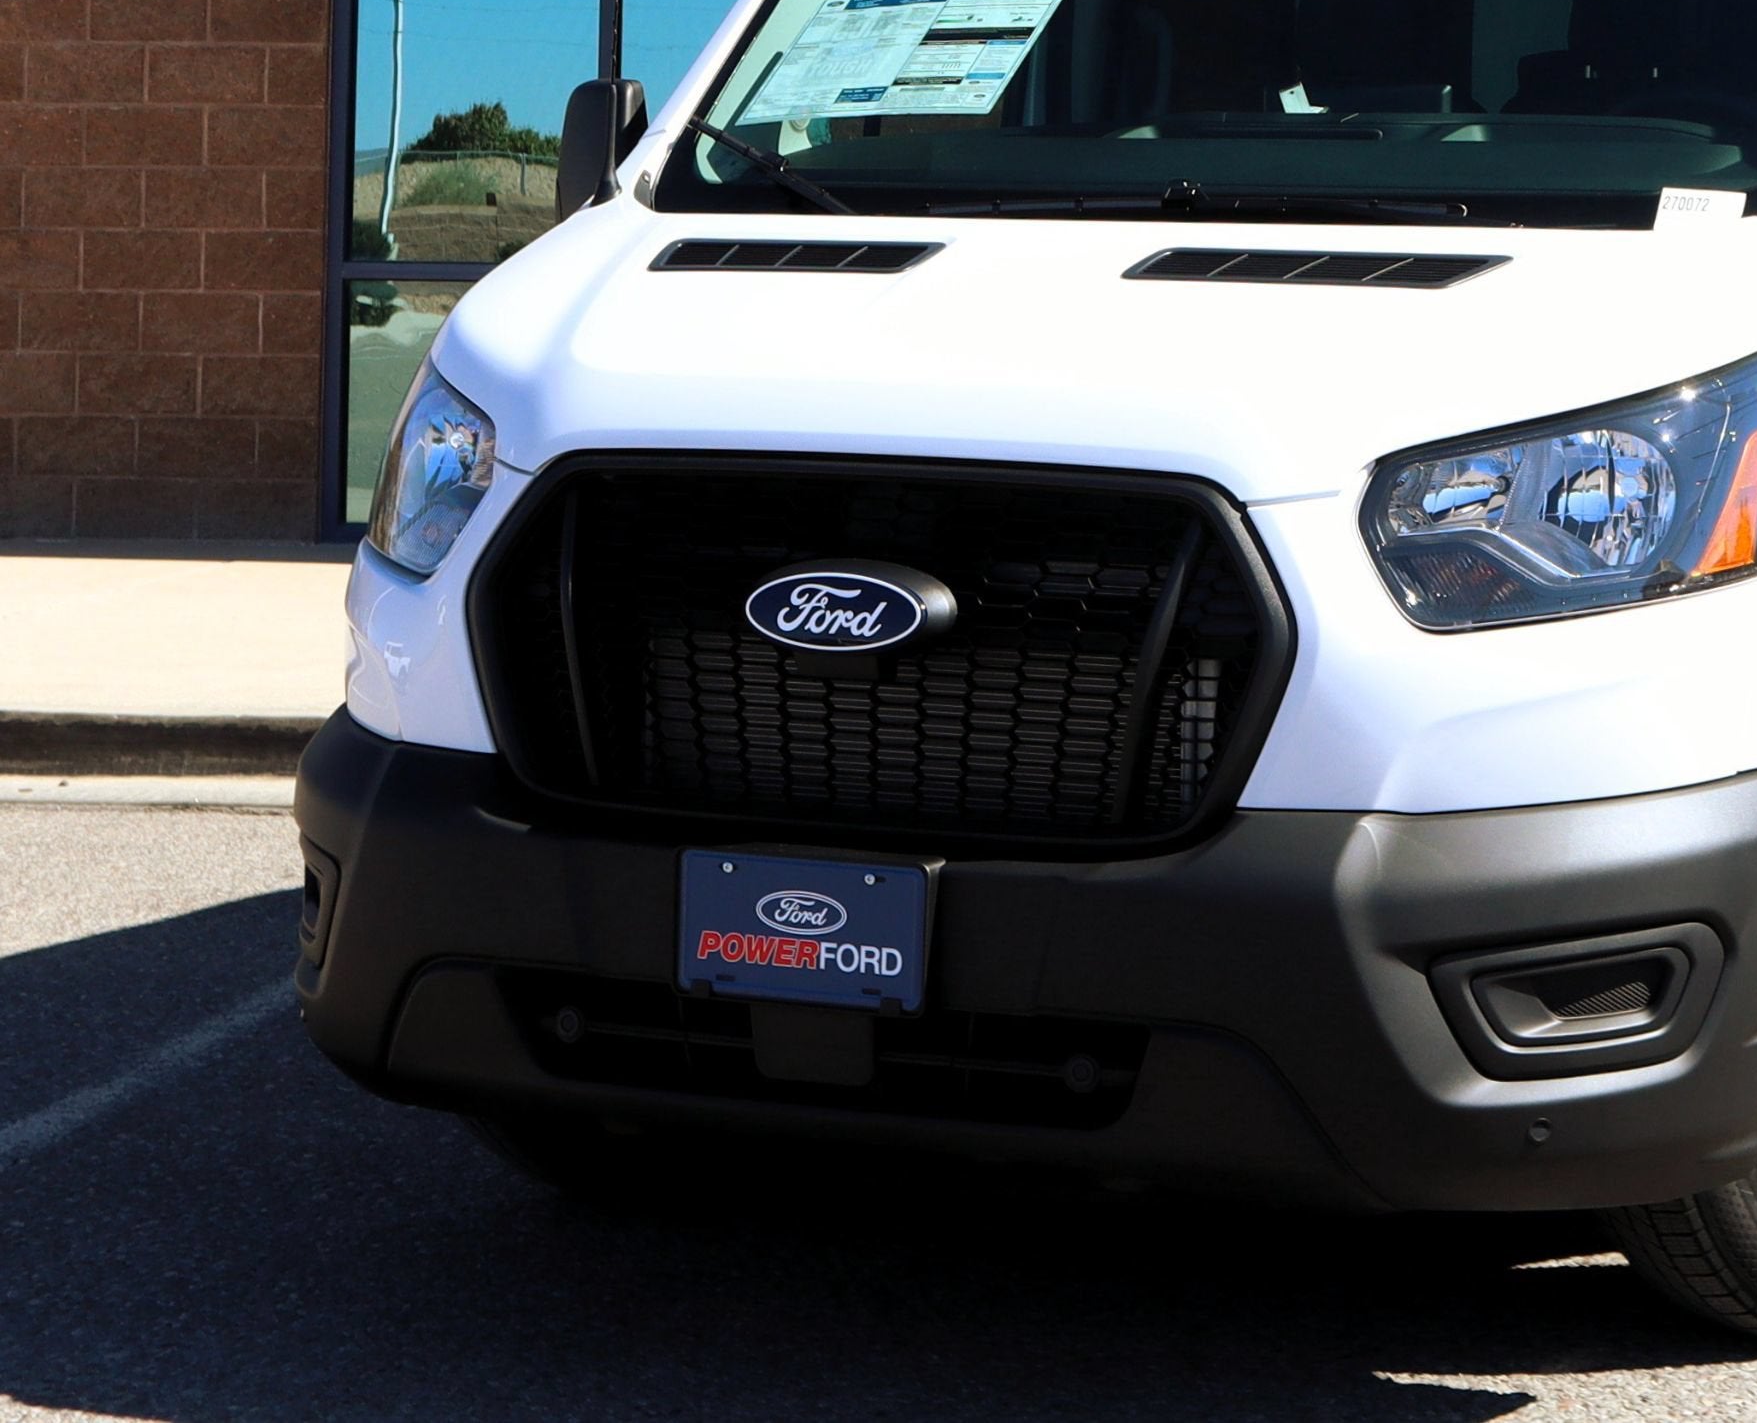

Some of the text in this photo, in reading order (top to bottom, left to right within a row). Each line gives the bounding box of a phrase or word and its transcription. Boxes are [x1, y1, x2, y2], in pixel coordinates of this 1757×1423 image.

[1661, 195, 1711, 212] 270072
[776, 583, 888, 638] Ford
[773, 897, 829, 927] Ford
[697, 930, 904, 977] POWERFORD
